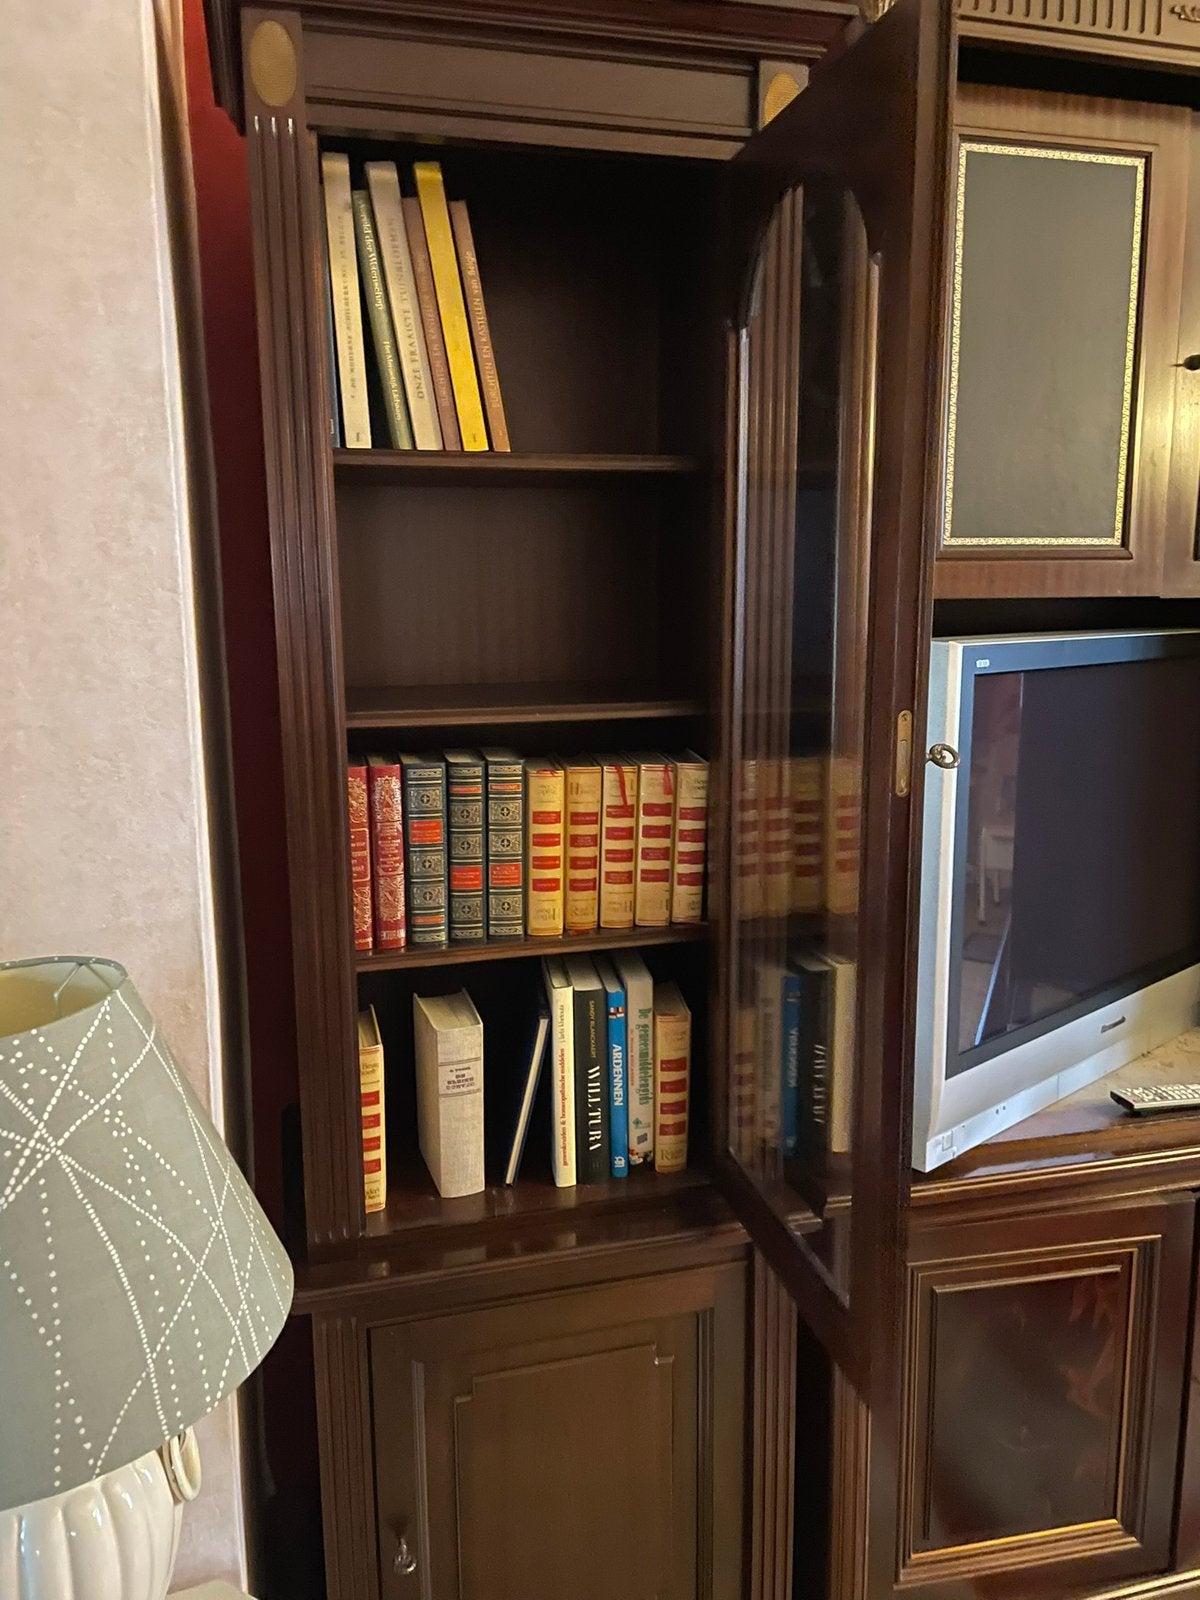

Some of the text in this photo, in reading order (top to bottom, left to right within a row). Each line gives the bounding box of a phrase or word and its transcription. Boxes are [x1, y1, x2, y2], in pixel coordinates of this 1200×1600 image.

[470, 279, 481, 294] van
[402, 309, 419, 363] FRAAISTE
[480, 345, 491, 359] EN
[412, 367, 425, 399] ONZE
[587, 1065, 601, 1108] WILL
[612, 1043, 624, 1106] ARDENNEN
[588, 1108, 602, 1151] TURA
